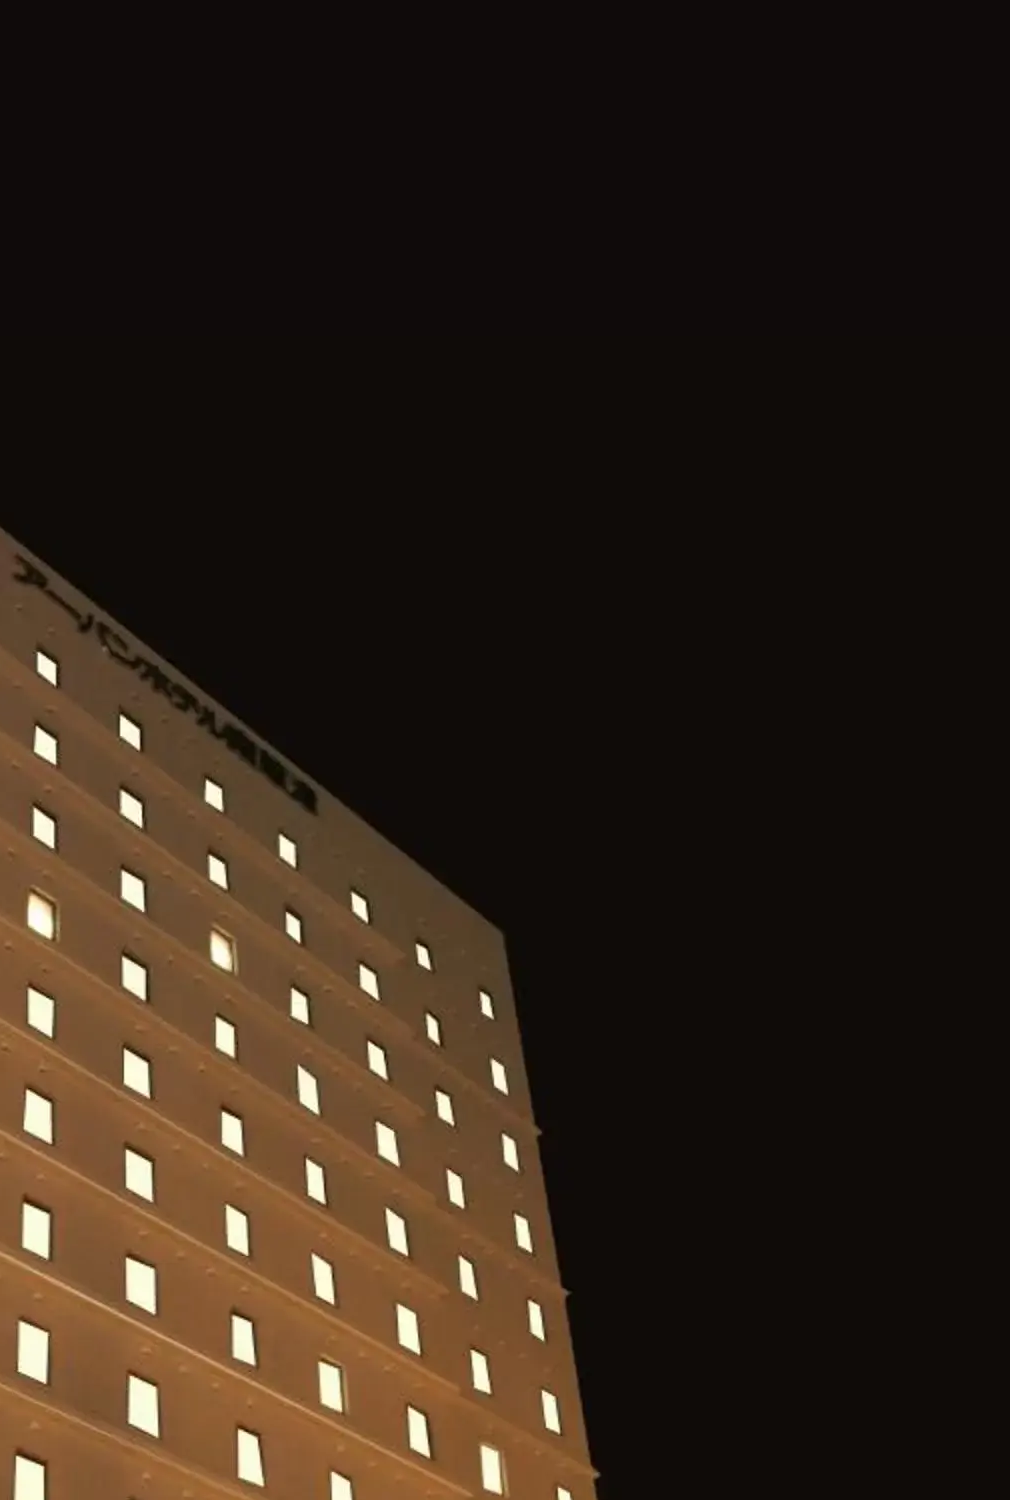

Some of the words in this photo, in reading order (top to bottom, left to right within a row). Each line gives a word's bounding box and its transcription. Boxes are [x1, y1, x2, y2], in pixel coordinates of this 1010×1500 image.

[11, 552, 319, 816] アーバンホテル
